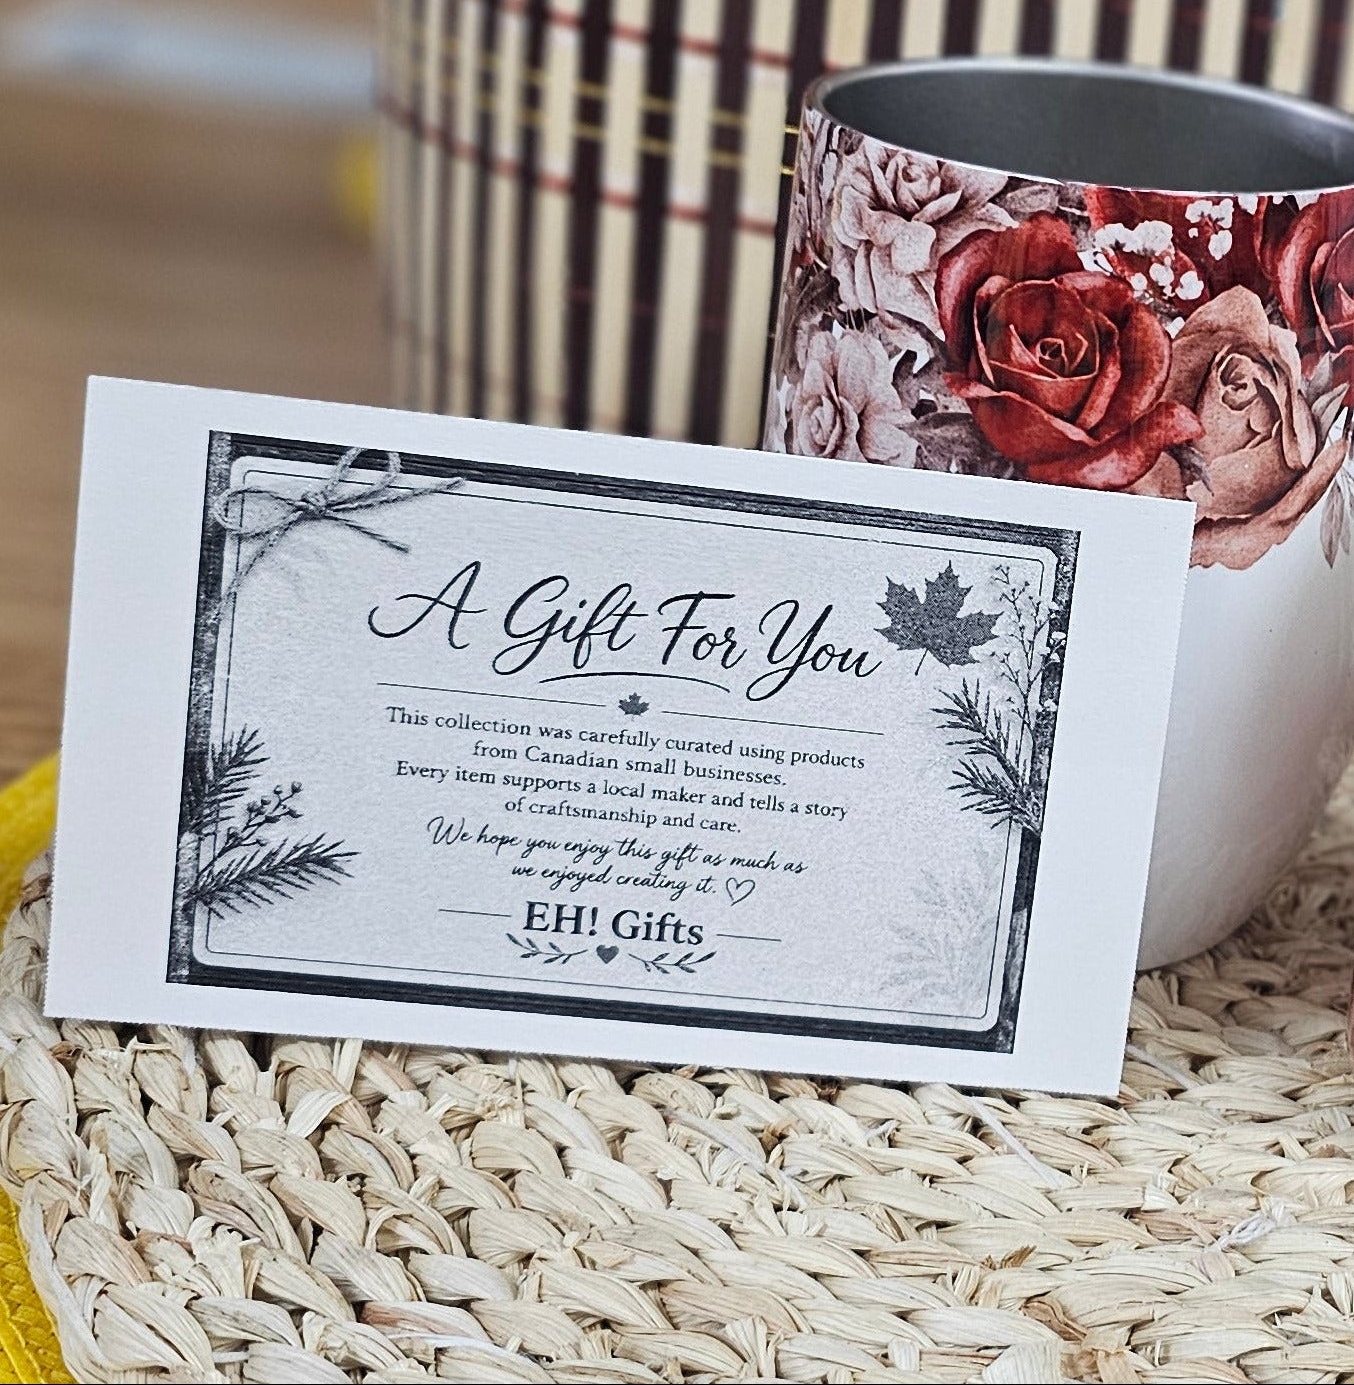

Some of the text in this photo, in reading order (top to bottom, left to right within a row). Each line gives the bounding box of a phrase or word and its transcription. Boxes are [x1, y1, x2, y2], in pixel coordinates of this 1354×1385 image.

[368, 561, 882, 701] A Gift For You
[386, 706, 865, 769] This collection was carefully curated using products
[473, 740, 786, 786] from Canadian small businesses.
[396, 760, 848, 821] Every item supports a local maker and tells a story
[505, 796, 741, 834] of craftsmanship and care.
[427, 816, 808, 874] We hope you enjoy this gift as much as
[512, 865, 716, 901] we enjoyed creating it.
[523, 901, 704, 945] EH! Gifts
